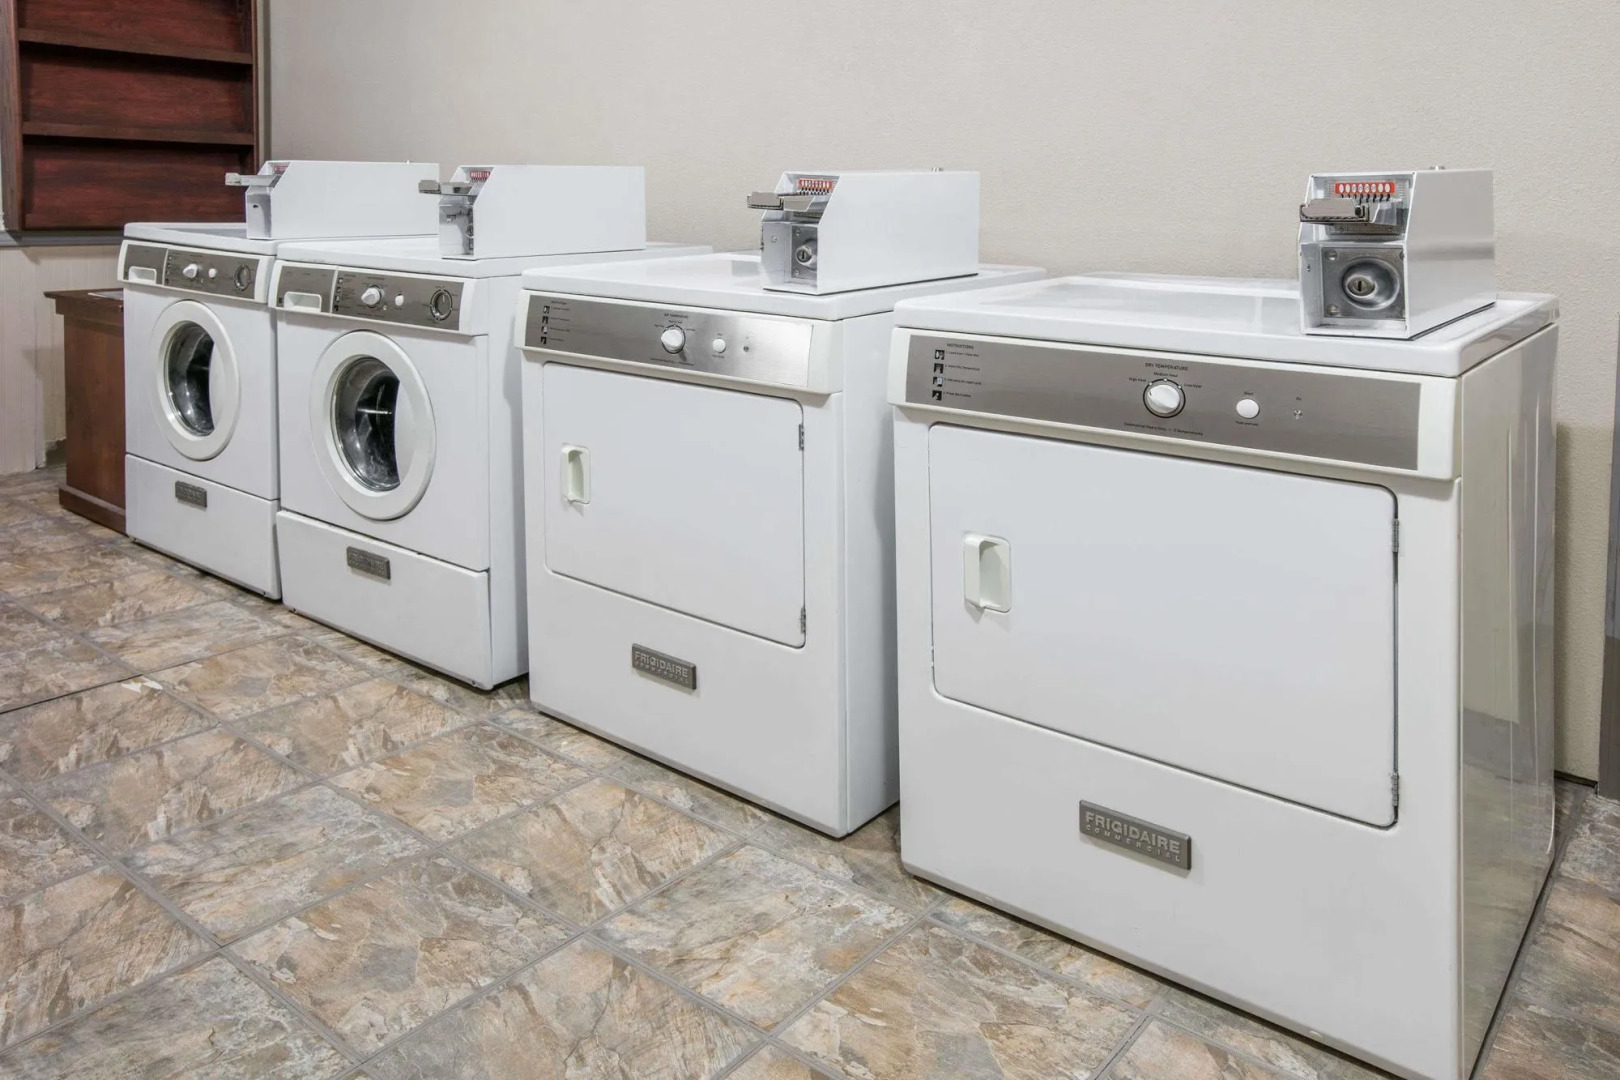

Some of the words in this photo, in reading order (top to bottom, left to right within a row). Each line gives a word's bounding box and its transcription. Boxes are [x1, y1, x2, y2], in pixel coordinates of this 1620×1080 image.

[635, 651, 688, 678] FRIGIDAIRE
[1085, 811, 1180, 853] FRIGIDAIRE
[1085, 825, 1180, 862] COMMERCIAL
